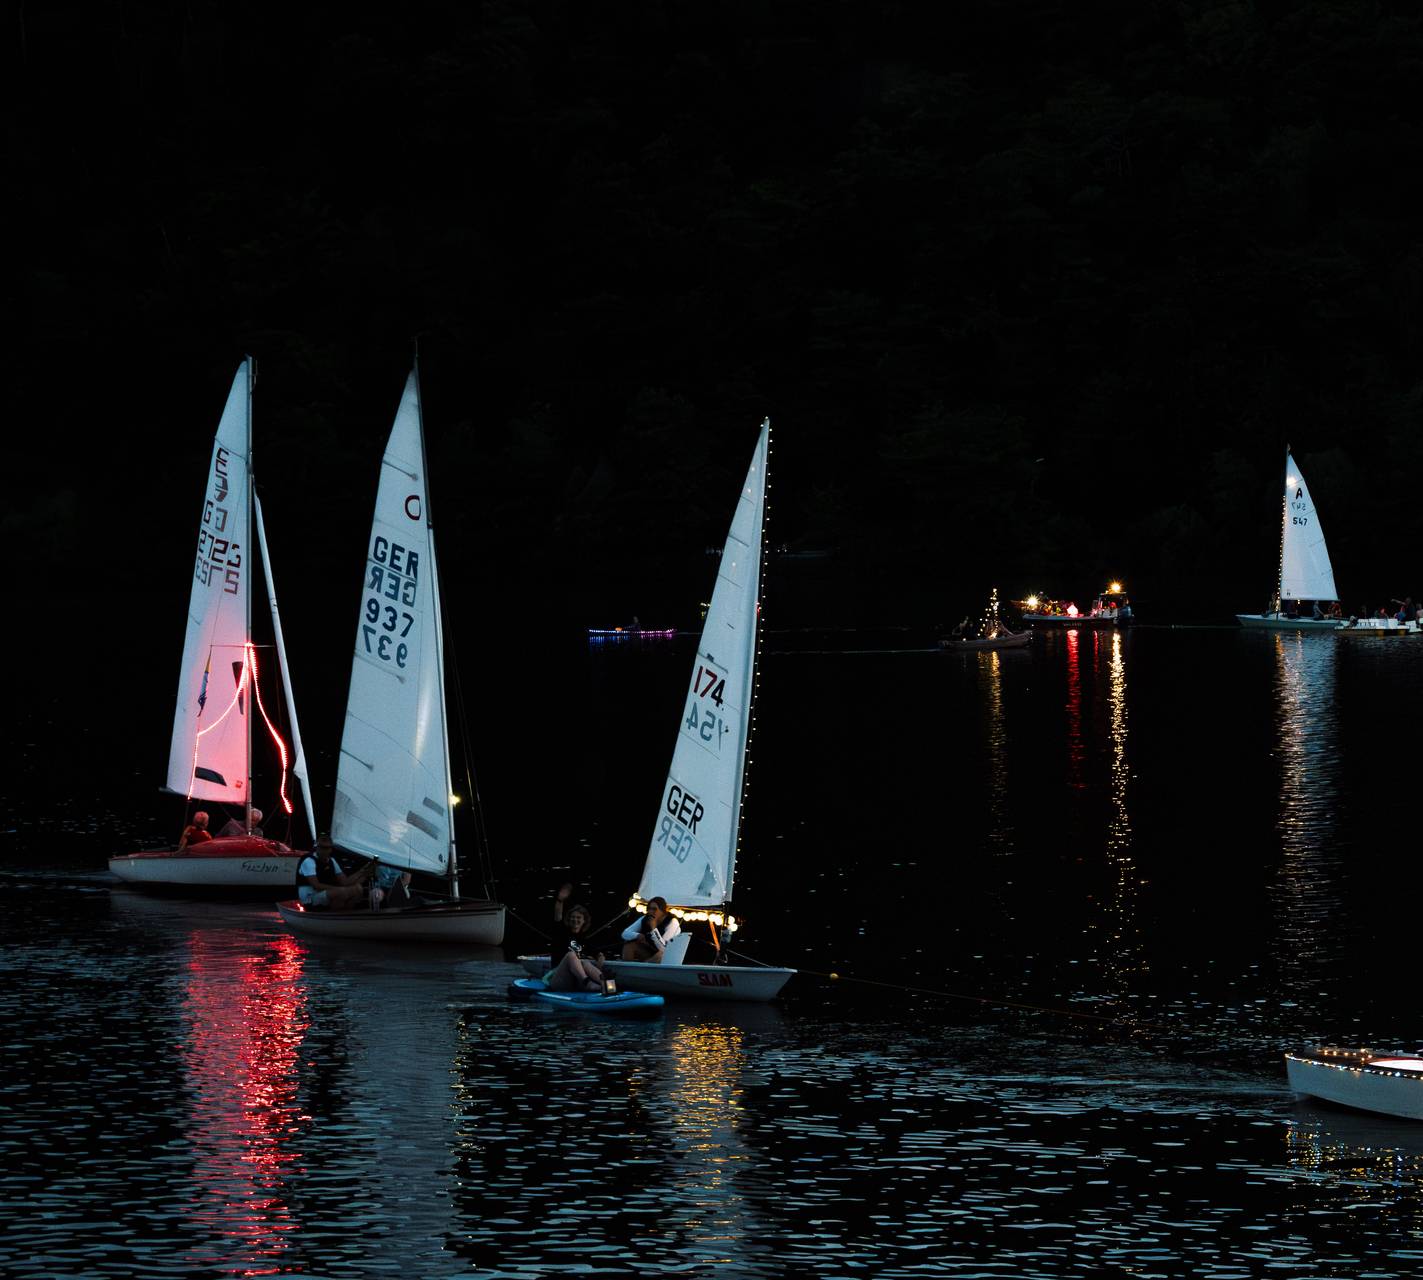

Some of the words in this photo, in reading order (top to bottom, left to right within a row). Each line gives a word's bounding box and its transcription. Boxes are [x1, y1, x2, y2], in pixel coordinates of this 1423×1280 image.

[1292, 516, 1308, 527] 547
[373, 535, 419, 582] GER
[366, 598, 414, 639] 937
[693, 664, 725, 708] 174
[666, 785, 704, 835] GER
